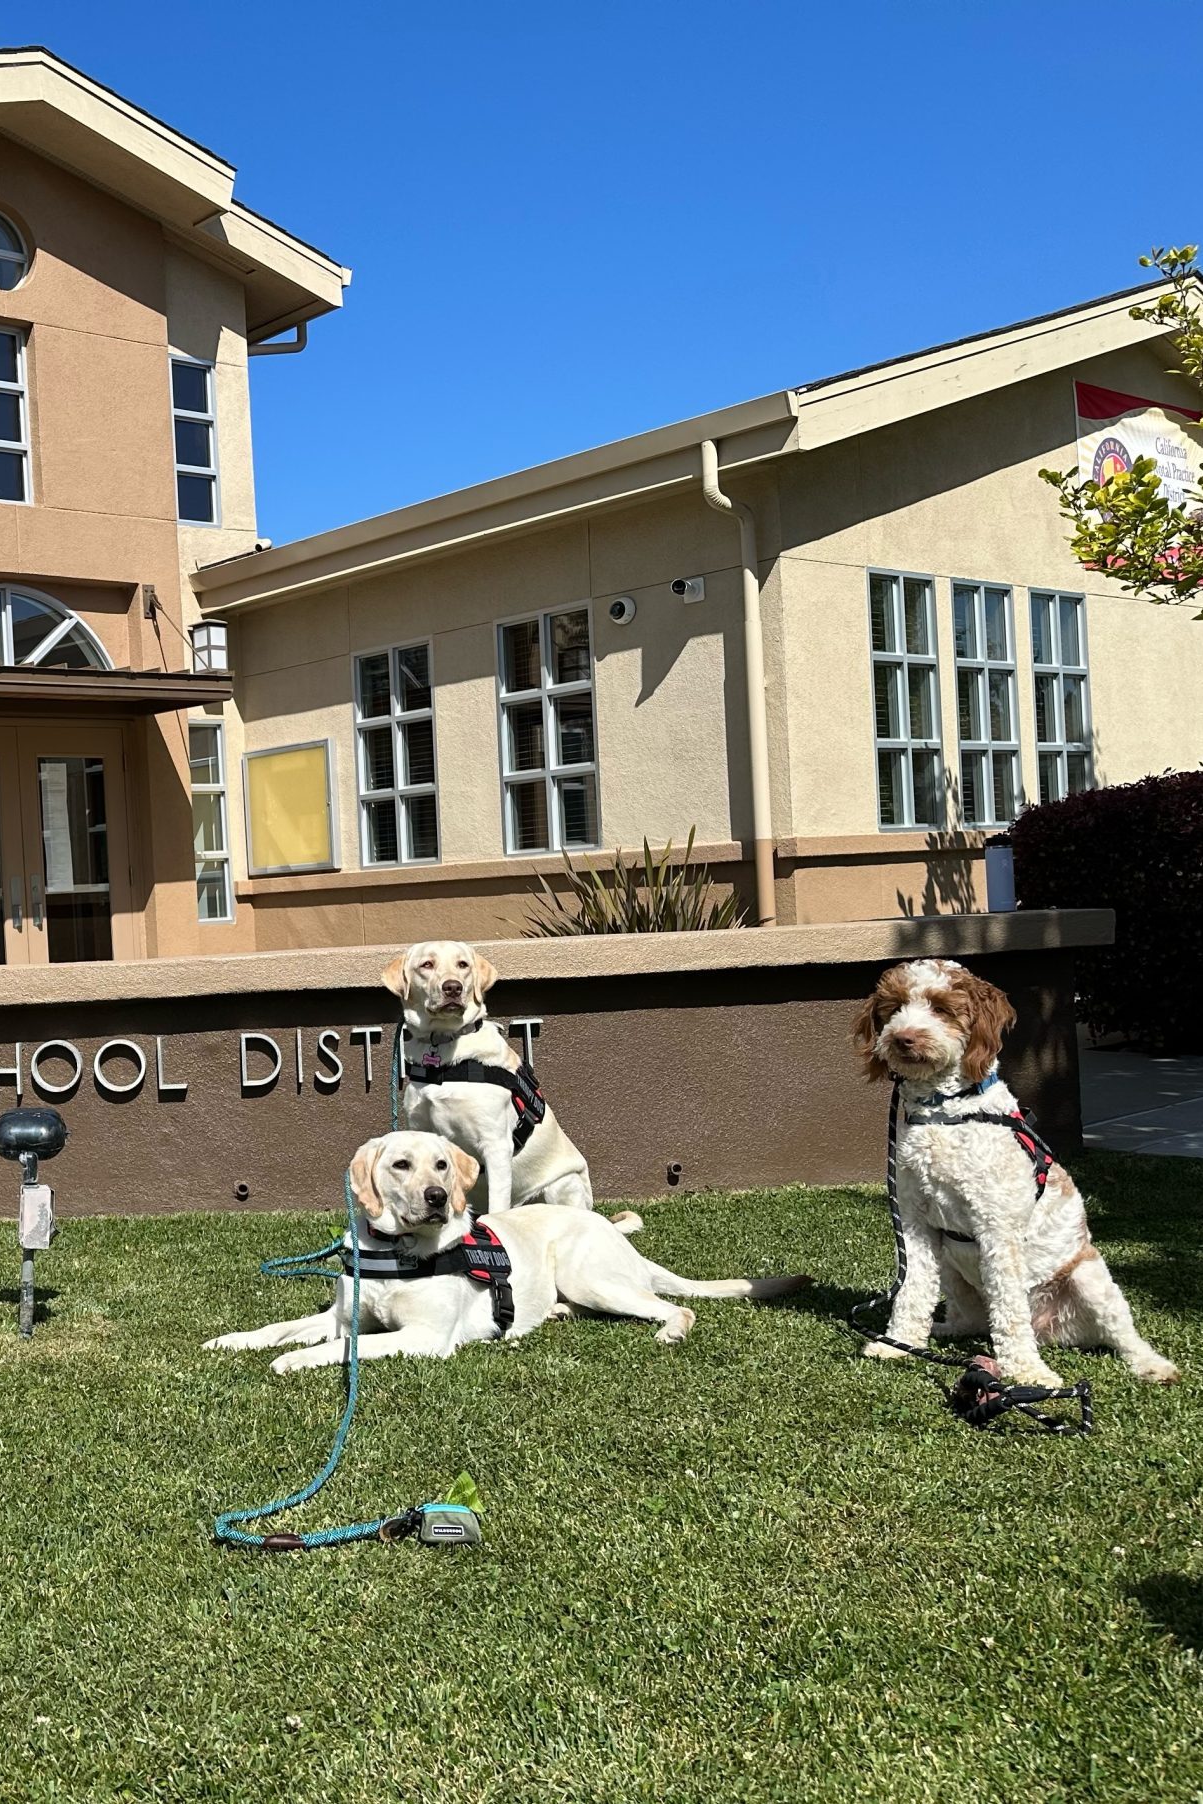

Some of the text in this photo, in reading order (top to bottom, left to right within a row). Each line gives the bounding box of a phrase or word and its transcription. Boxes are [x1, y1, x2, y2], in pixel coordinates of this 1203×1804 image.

[1155, 436, 1188, 460] California
[1093, 440, 1128, 482] CALIFORNIA
[1170, 462, 1195, 484] Practice
[240, 1021, 542, 1087] DISTT
[492, 1251, 510, 1267] DOG
